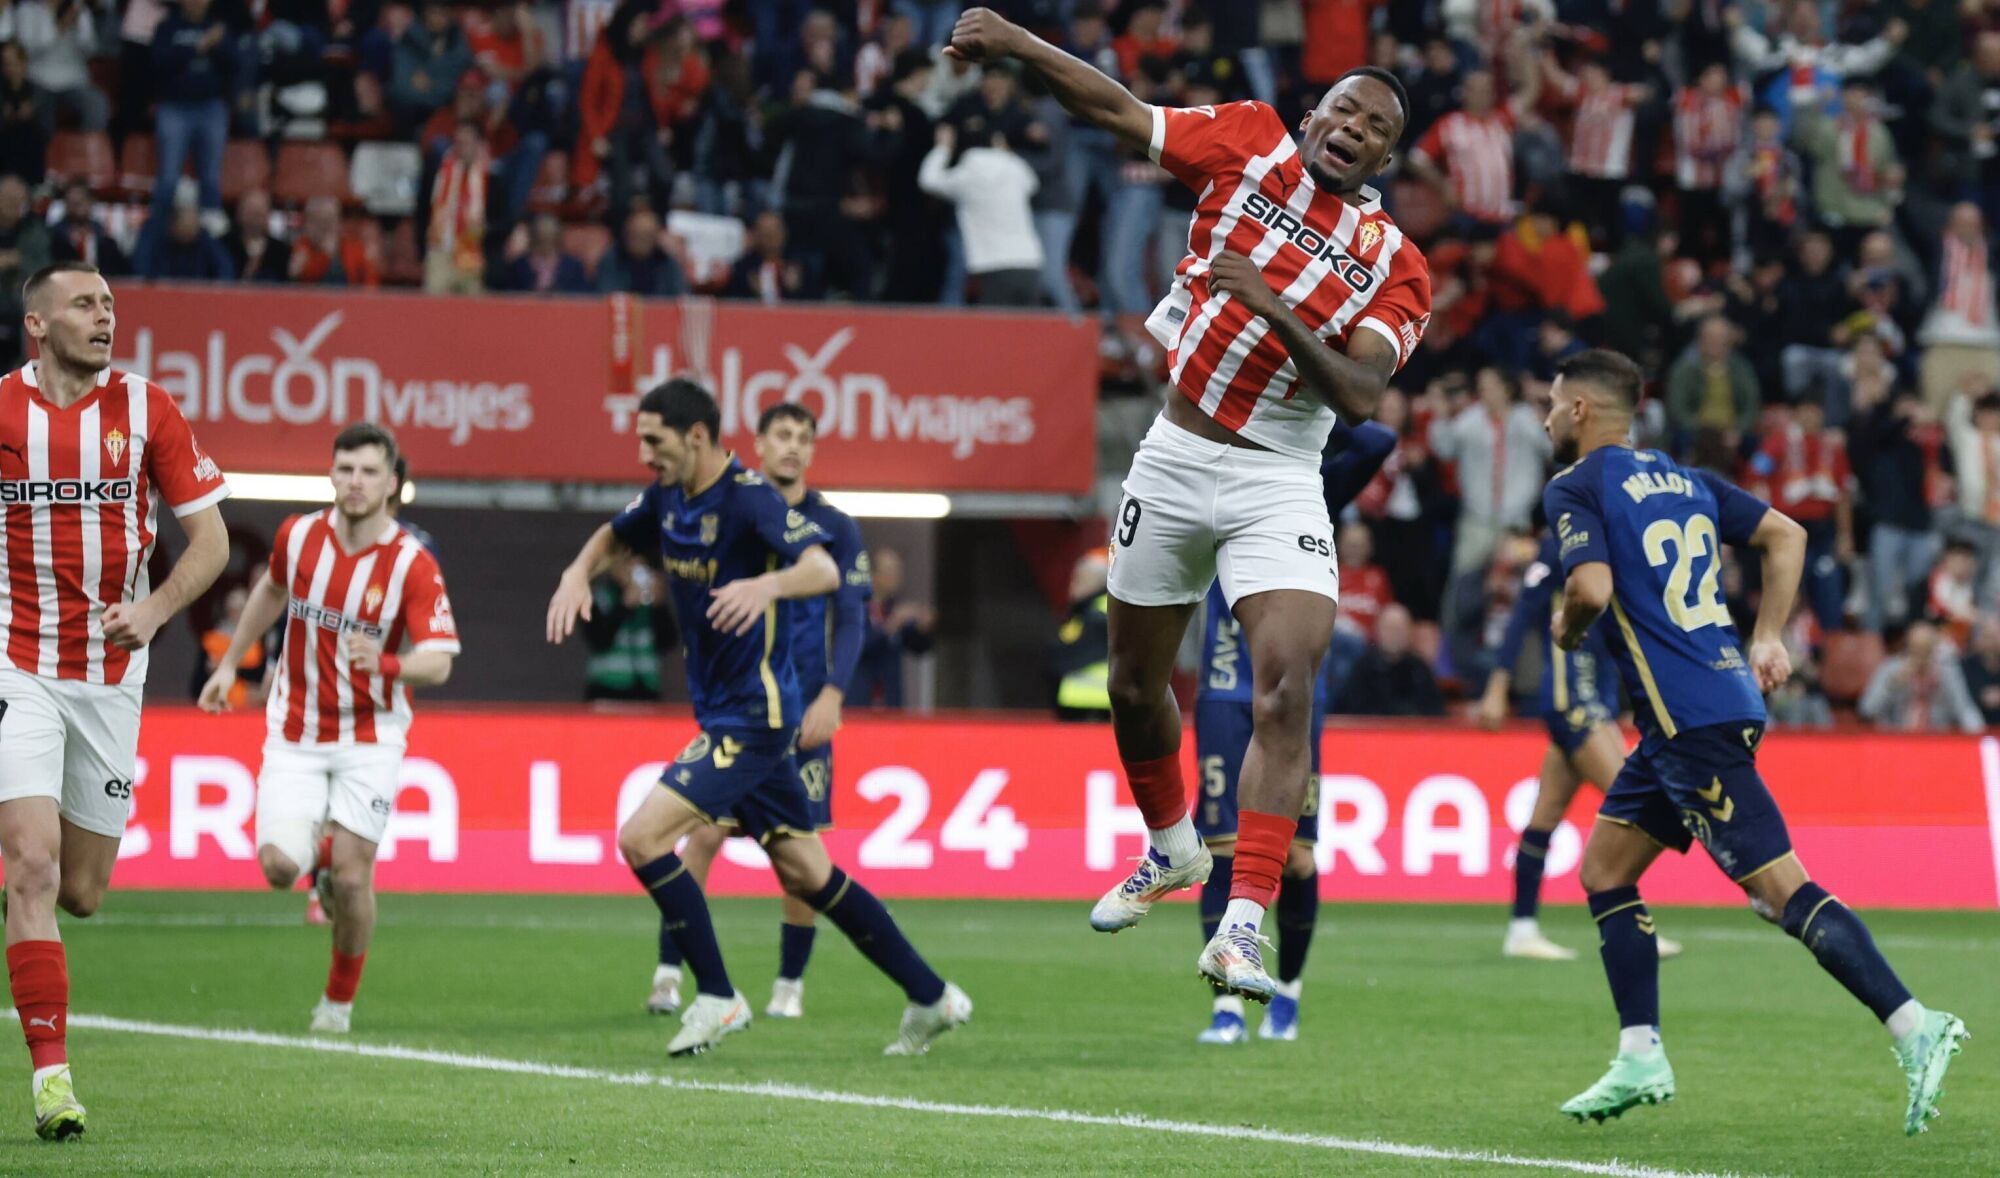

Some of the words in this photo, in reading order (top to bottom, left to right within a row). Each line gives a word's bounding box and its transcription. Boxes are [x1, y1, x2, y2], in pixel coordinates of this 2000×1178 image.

[1241, 192, 1374, 294] SIROKO
[0, 481, 132, 501] SIROKO
[1114, 493, 1141, 547] 9
[1643, 513, 1735, 633] 22
[856, 765, 1029, 870] 24
[1085, 770, 1583, 881] HRAS
